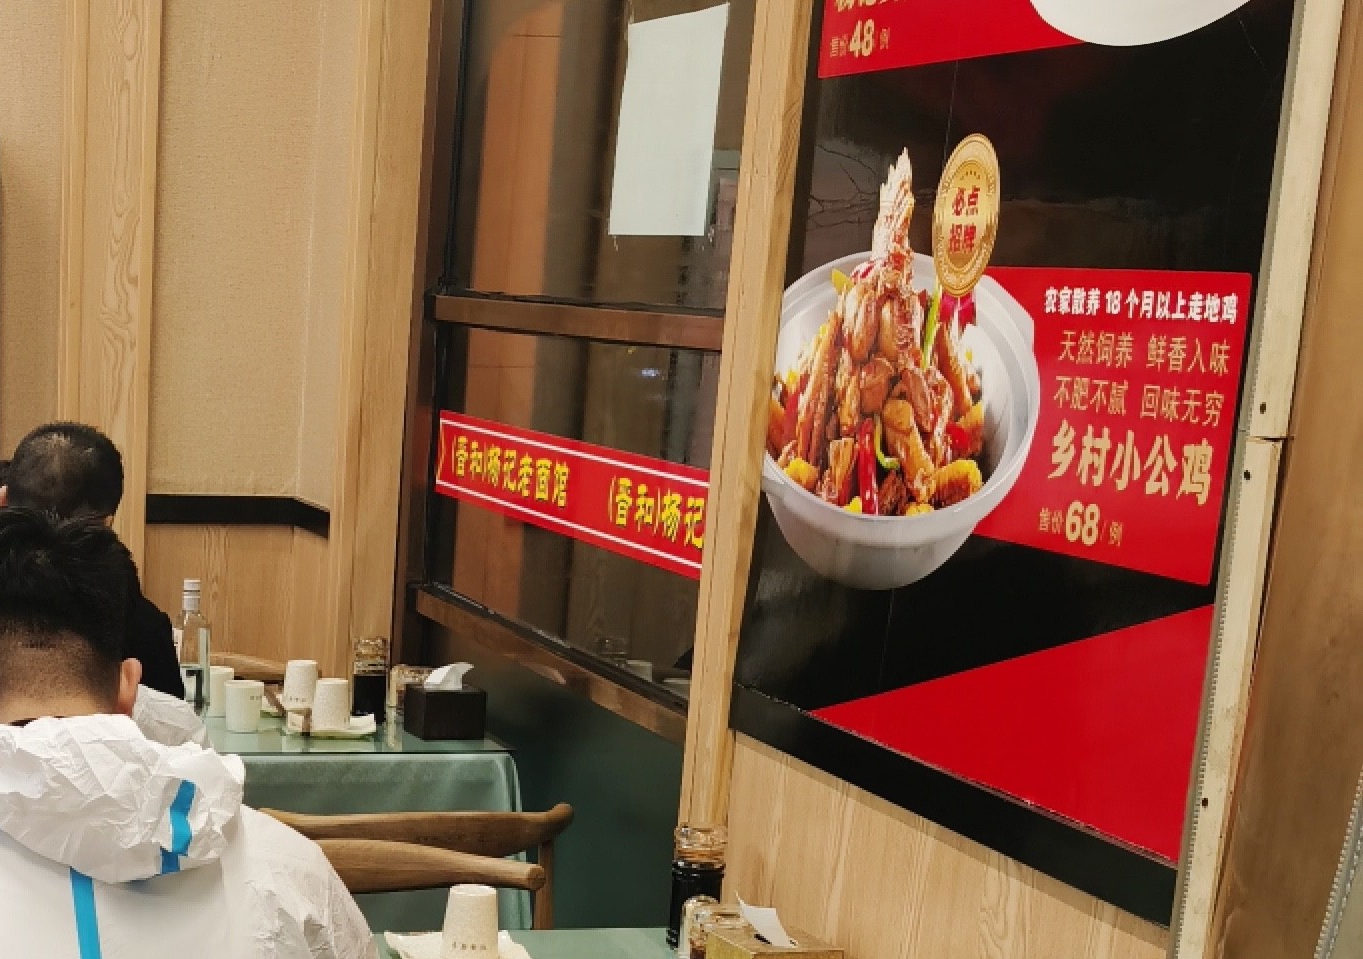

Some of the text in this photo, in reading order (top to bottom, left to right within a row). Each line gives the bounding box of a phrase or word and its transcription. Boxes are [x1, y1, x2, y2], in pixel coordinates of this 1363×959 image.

[1058, 330, 1230, 375] 天然饲养 鲜香入味
[1053, 375, 1225, 427] 不肥不腻 回味无穷
[1047, 418, 1214, 506] 乡村小公鸡
